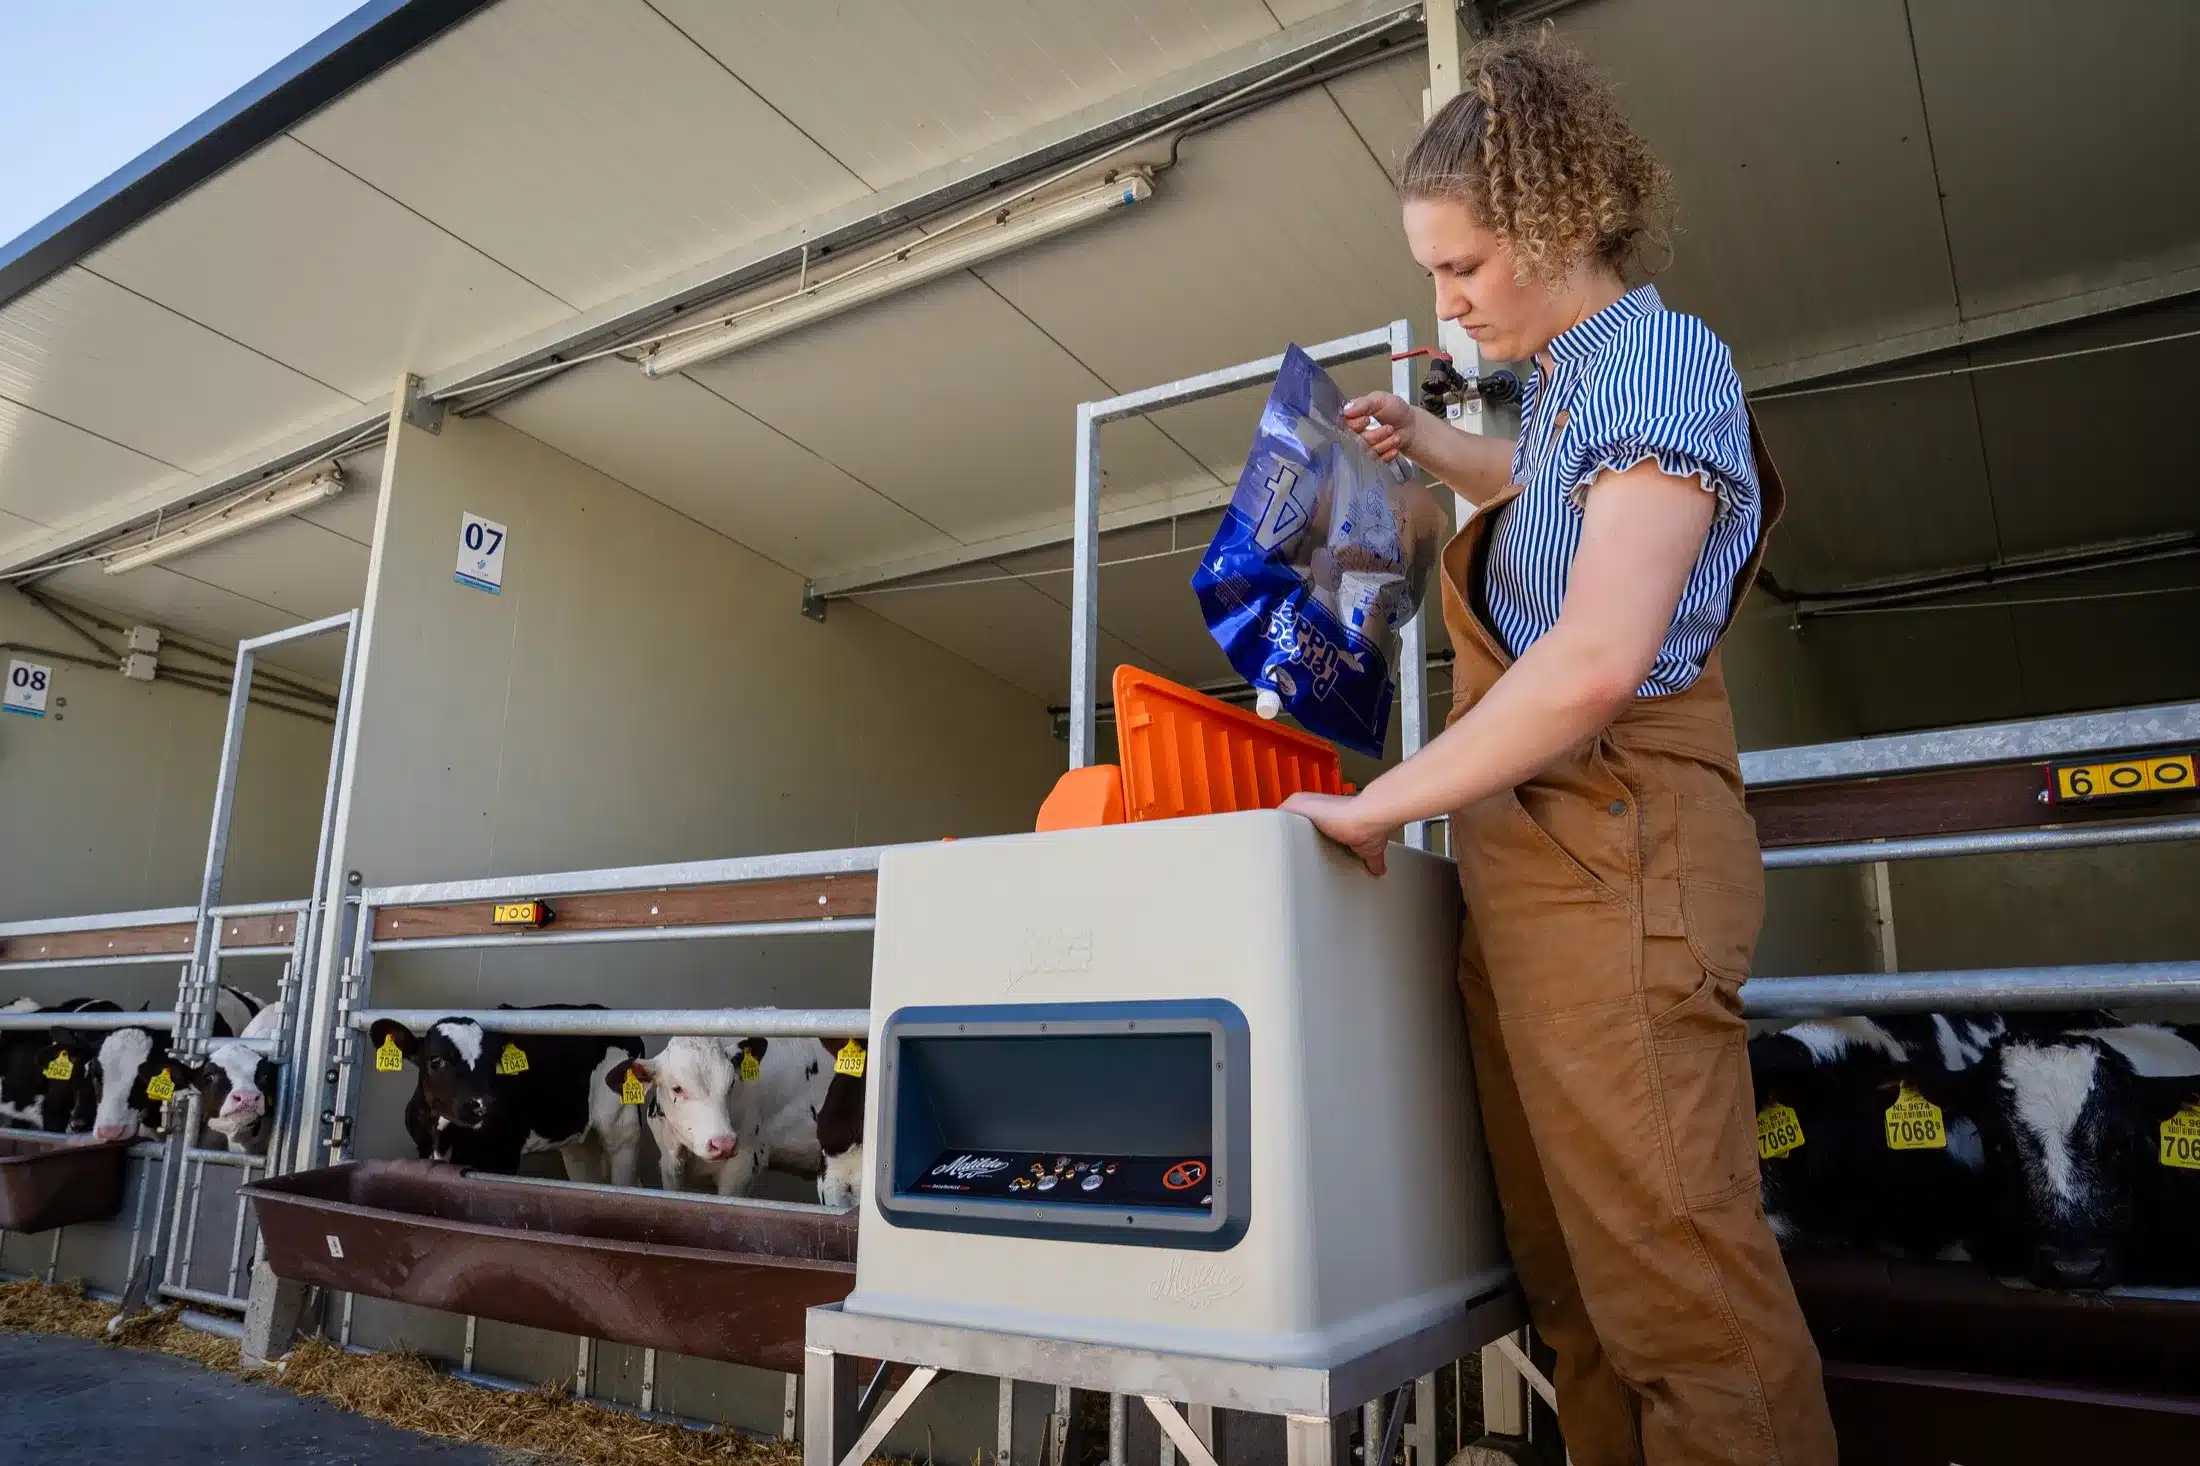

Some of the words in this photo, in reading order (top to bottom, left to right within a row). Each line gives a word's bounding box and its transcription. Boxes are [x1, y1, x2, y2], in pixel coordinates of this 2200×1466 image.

[1254, 464, 1309, 553] 4
[465, 522, 504, 555] 07
[13, 667, 46, 691] 08
[2069, 762, 2188, 796] 600
[498, 906, 531, 922] 700
[380, 1057, 400, 1068] 7043
[504, 1058, 526, 1072] 7043
[839, 1058, 862, 1070] 7039
[625, 1090, 642, 1102] 7041
[1893, 1104, 1907, 1112] NL
[1908, 1102, 1930, 1111] 9674
[2170, 1117, 2186, 1127] NL
[932, 1154, 1010, 1179] Matilda
